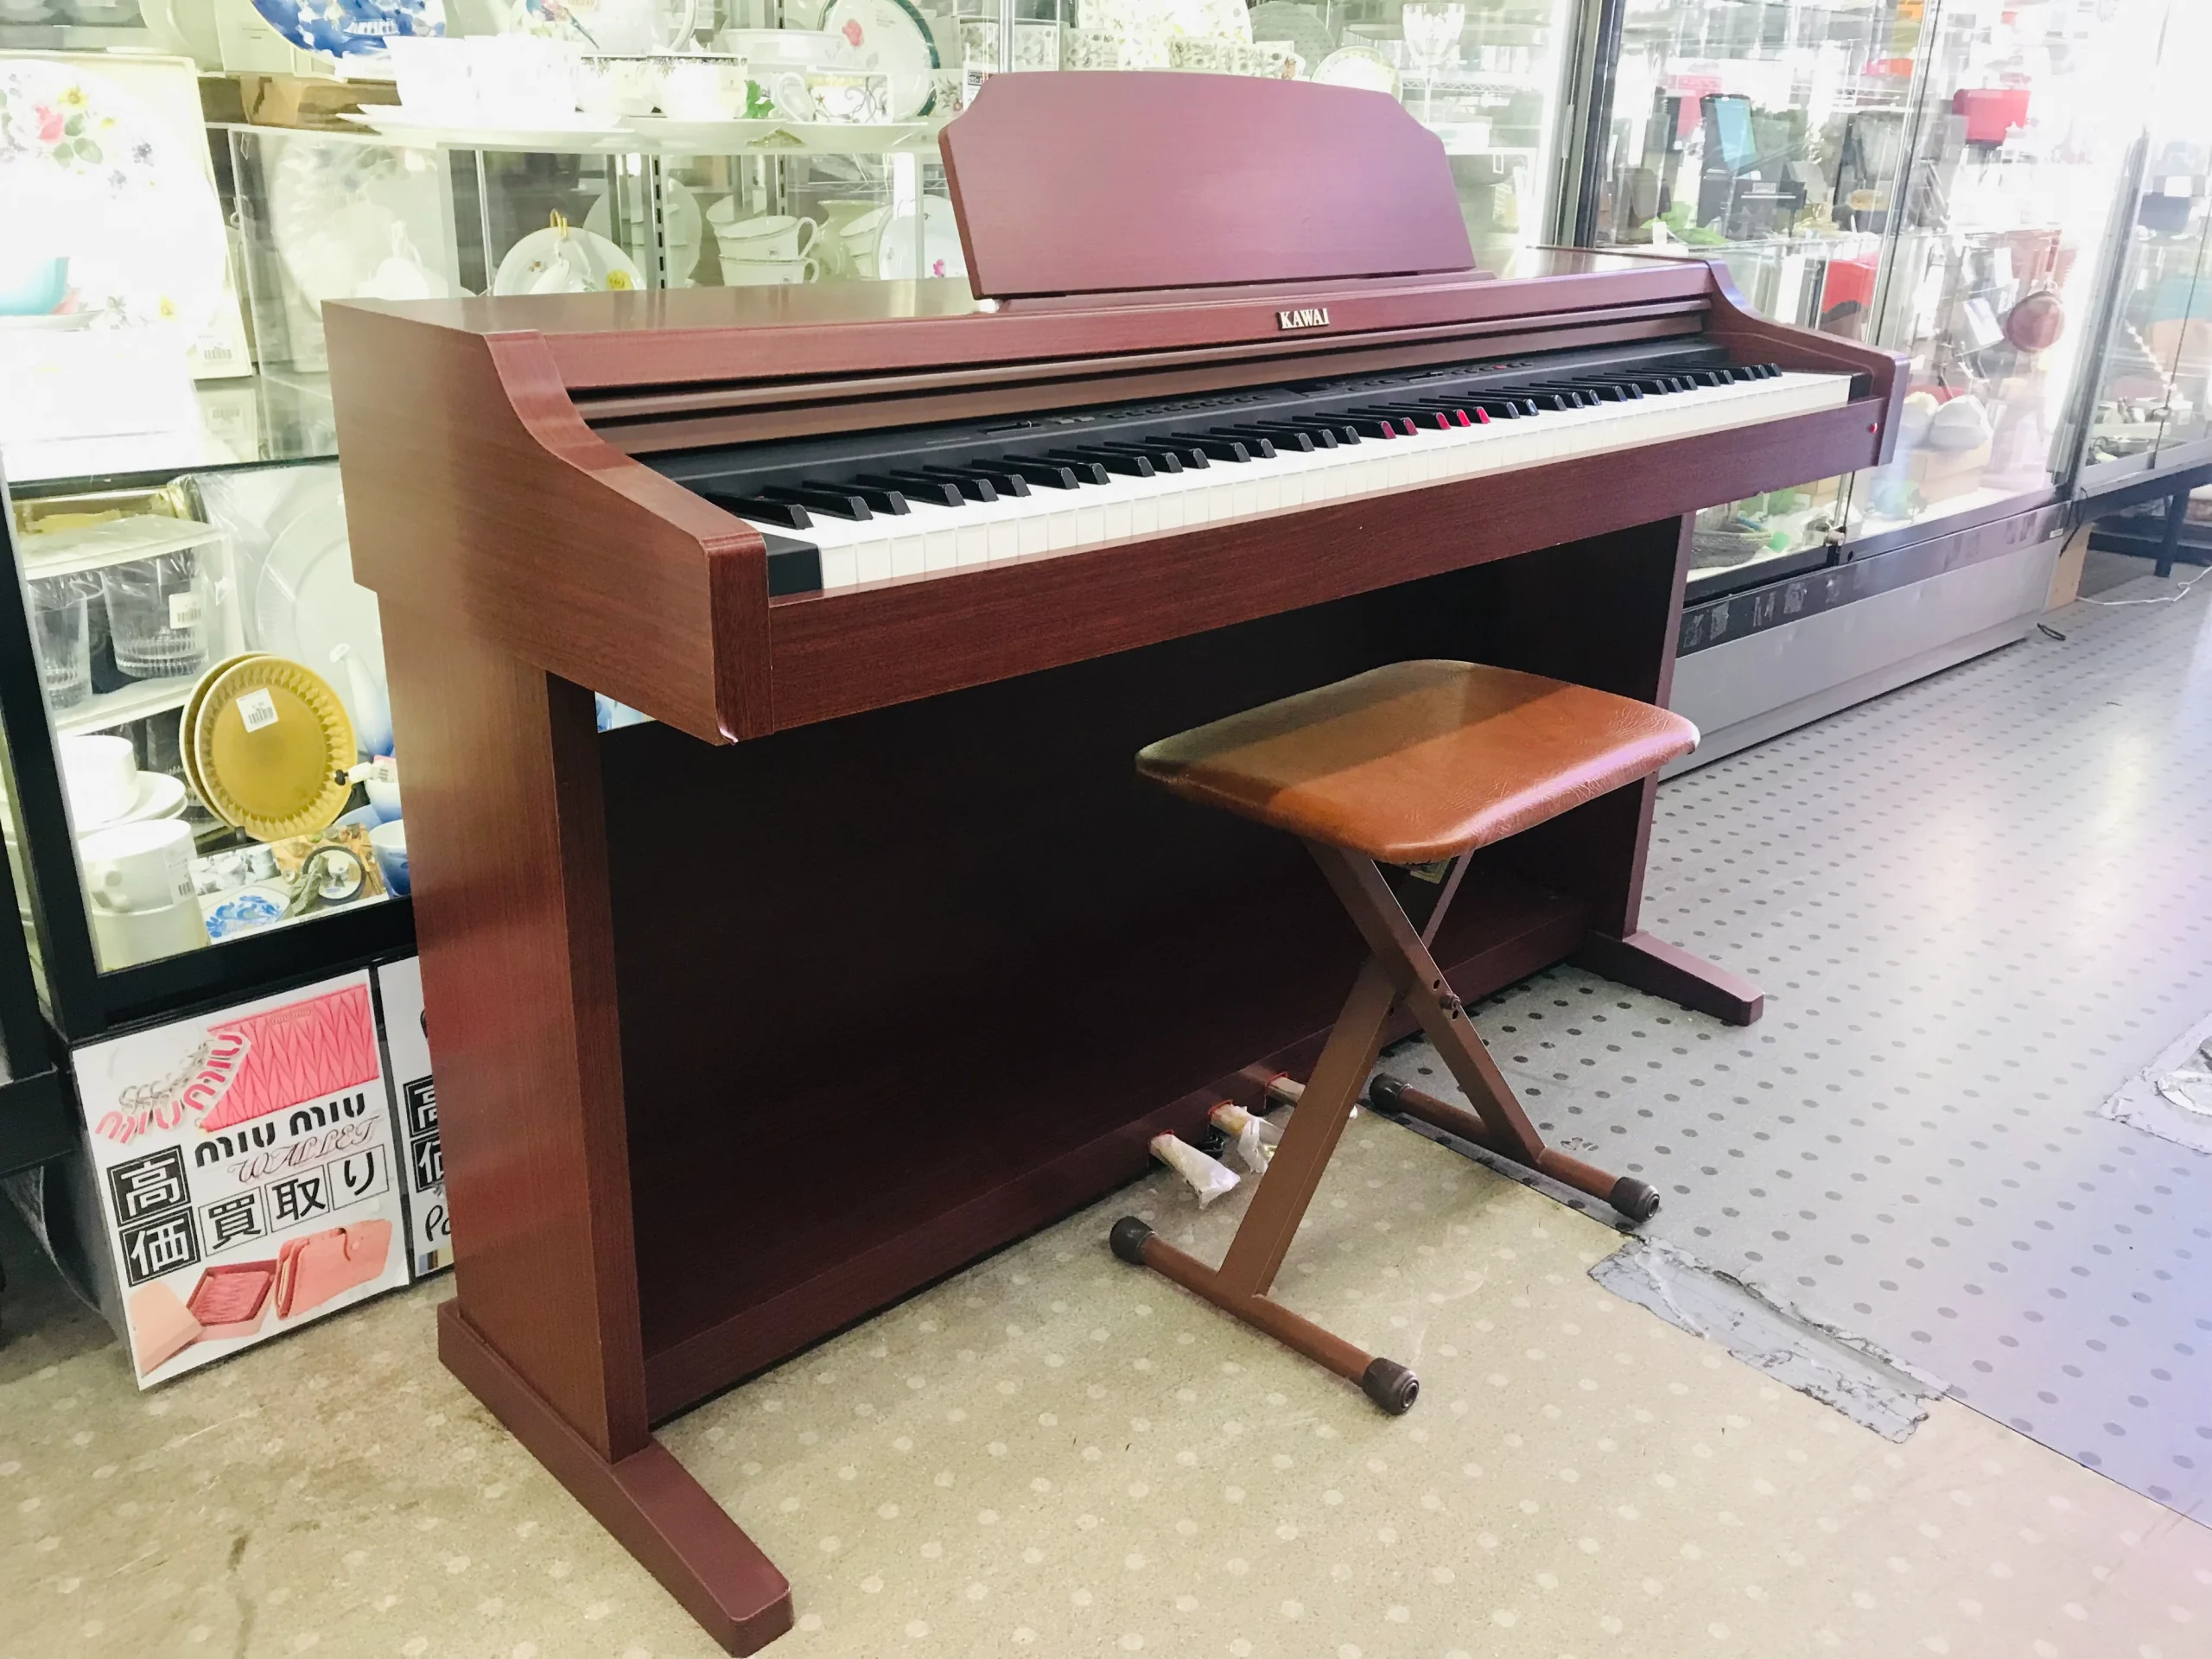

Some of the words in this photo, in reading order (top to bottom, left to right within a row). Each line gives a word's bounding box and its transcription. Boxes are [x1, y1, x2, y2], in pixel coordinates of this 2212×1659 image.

[1279, 308, 1330, 329] KAWAI
[194, 1122, 276, 1168] miu
[289, 1093, 365, 1137] miu
[226, 1115, 381, 1183] WALLET
